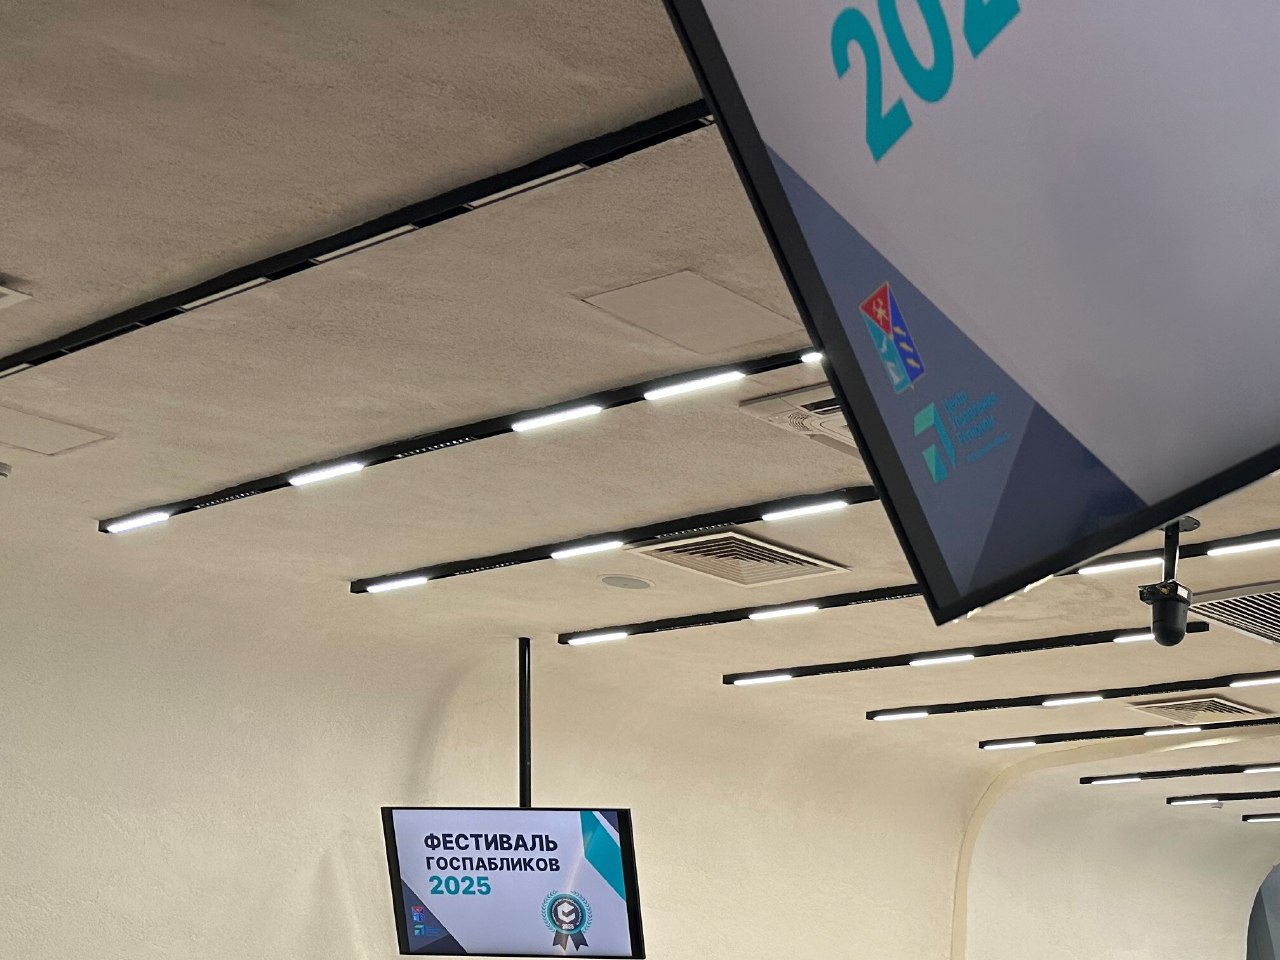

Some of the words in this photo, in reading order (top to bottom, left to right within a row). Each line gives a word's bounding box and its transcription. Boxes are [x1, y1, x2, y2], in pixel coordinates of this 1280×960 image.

[423, 833, 558, 852] ФЕСТИВАЛЬ
[425, 856, 561, 872] ГОСПАБЛИКОВ
[428, 875, 492, 896] 2025
